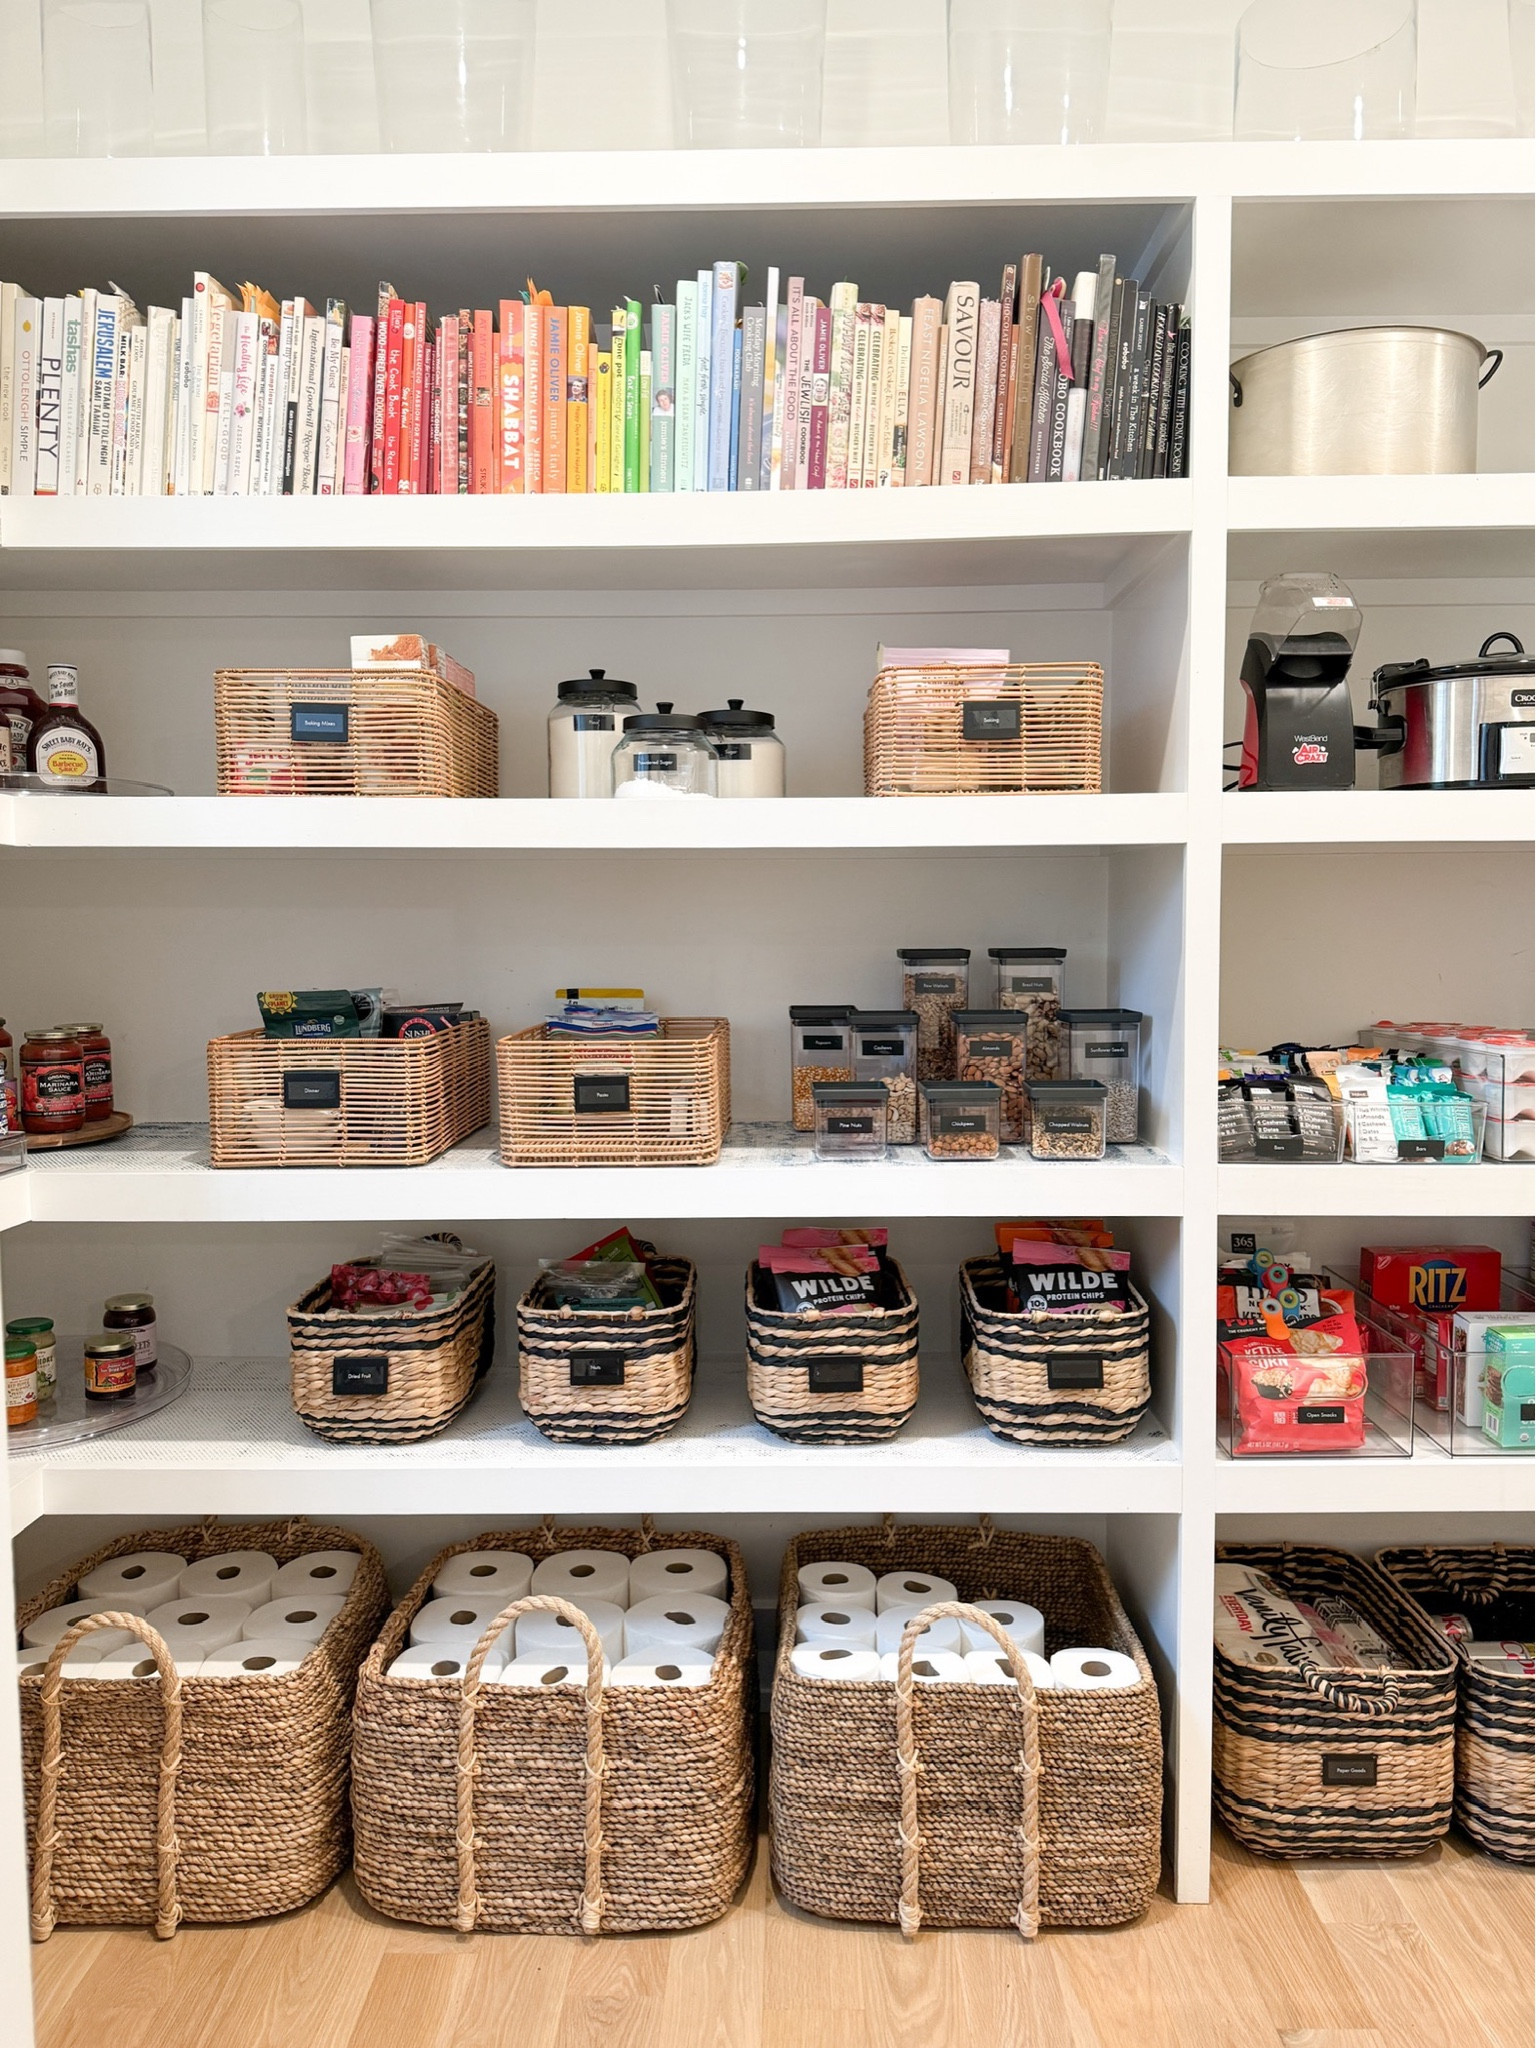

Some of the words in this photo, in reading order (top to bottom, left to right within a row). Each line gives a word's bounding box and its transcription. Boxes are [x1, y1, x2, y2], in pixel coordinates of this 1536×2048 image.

[684, 296, 693, 320] JACK'S
[792, 286, 800, 303] IT'S
[529, 312, 539, 347] LIVING
[575, 311, 584, 341] Jamie
[660, 311, 670, 344] JAMIE
[791, 306, 800, 327] ALL
[923, 308, 934, 345] FEAST
[1001, 297, 1011, 346] CHOCOLATE
[66, 319, 81, 373] tashas
[95, 308, 115, 378] JERUSALEM
[330, 338, 340, 348] Be
[377, 321, 387, 372] WOOD-FIRED
[549, 317, 559, 354] JAMIE
[682, 324, 691, 342] WIFE
[744, 317, 754, 351] Cooking
[754, 317, 763, 348] Monday
[789, 329, 798, 365] ABOUT
[841, 312, 853, 354] WHAT
[952, 295, 974, 389] SAVOUR
[1167, 342, 1176, 354] the
[308, 329, 319, 384] International
[328, 350, 339, 364] My
[389, 349, 399, 365] the
[575, 343, 584, 373] Oliver
[615, 362, 623, 378] pot
[660, 346, 669, 383] OLIVER
[751, 351, 761, 387] Morning
[853, 330, 866, 380] CELEBRATING
[870, 331, 881, 381] CELEBRATING
[1178, 342, 1190, 385] COOKING
[20, 351, 30, 423] OTTOLENGHI
[328, 365, 338, 388] Guest
[376, 373, 385, 394] OVEN
[388, 368, 398, 390] Cook
[529, 360, 538, 405] HEALTHY
[549, 358, 559, 402] OLIVER
[788, 369, 796, 388] THE
[918, 350, 931, 405] NIGELLA
[999, 349, 1008, 396] COOKBOOK
[1131, 374, 1140, 394] week
[1162, 355, 1175, 397] hummingbird
[94, 380, 102, 401] SAMI
[102, 381, 111, 410] YOTAM
[116, 380, 125, 411] KIDS
[615, 380, 623, 414] wonders
[786, 391, 796, 420] FOOD
[898, 391, 906, 417] ELLA
[1176, 389, 1187, 409] WITH
[39, 357, 61, 458] PLENTY
[92, 404, 101, 436] TAMIMI
[305, 387, 316, 427] Goodwill
[374, 397, 384, 440] COOKBOOK
[388, 395, 399, 418] Book
[503, 374, 519, 469] SHABBAT
[529, 409, 537, 431] LIFE
[837, 397, 849, 424] ATE
[996, 403, 1005, 436] CHRISTINE
[1037, 388, 1050, 425] Kitchen
[1129, 405, 1138, 421] The
[1159, 399, 1171, 422] bakery
[99, 413, 110, 466] OTTOLENGHI
[114, 413, 124, 447] ONLY
[547, 406, 559, 449] jamie's
[659, 421, 669, 450] jamie's
[915, 412, 928, 470] LAWSON
[1050, 403, 1067, 476] COOKBOOK
[1126, 423, 1136, 452] Kitchen
[1158, 423, 1168, 454] cookbook
[19, 425, 29, 462] SIMPLE
[301, 430, 313, 463] Recipe
[547, 454, 559, 480] italy
[660, 452, 668, 483] dinners
[42, 737, 59, 752] SWEET
[60, 736, 75, 745] BABY
[76, 737, 92, 753] RAY'S
[1294, 753, 1328, 764] CRAZY
[1299, 743, 1319, 754] AIR
[52, 760, 84, 768] Barbecue
[295, 1023, 331, 1035] LUNDBERG
[1233, 1237, 1253, 1248] 365
[791, 1275, 875, 1299] WILDE
[1028, 1272, 1118, 1292] WILDE
[1046, 1293, 1080, 1301] PROTEIN
[1408, 1266, 1467, 1306] RITZ
[813, 1295, 844, 1305] PROTEIN
[845, 1293, 866, 1301] CHIPS
[1244, 1346, 1285, 1355] KETTLE
[1223, 1595, 1254, 1633] EVERYDAY
[1234, 1589, 1304, 1639] Vanity
[1336, 1767, 1351, 1775] Paper
